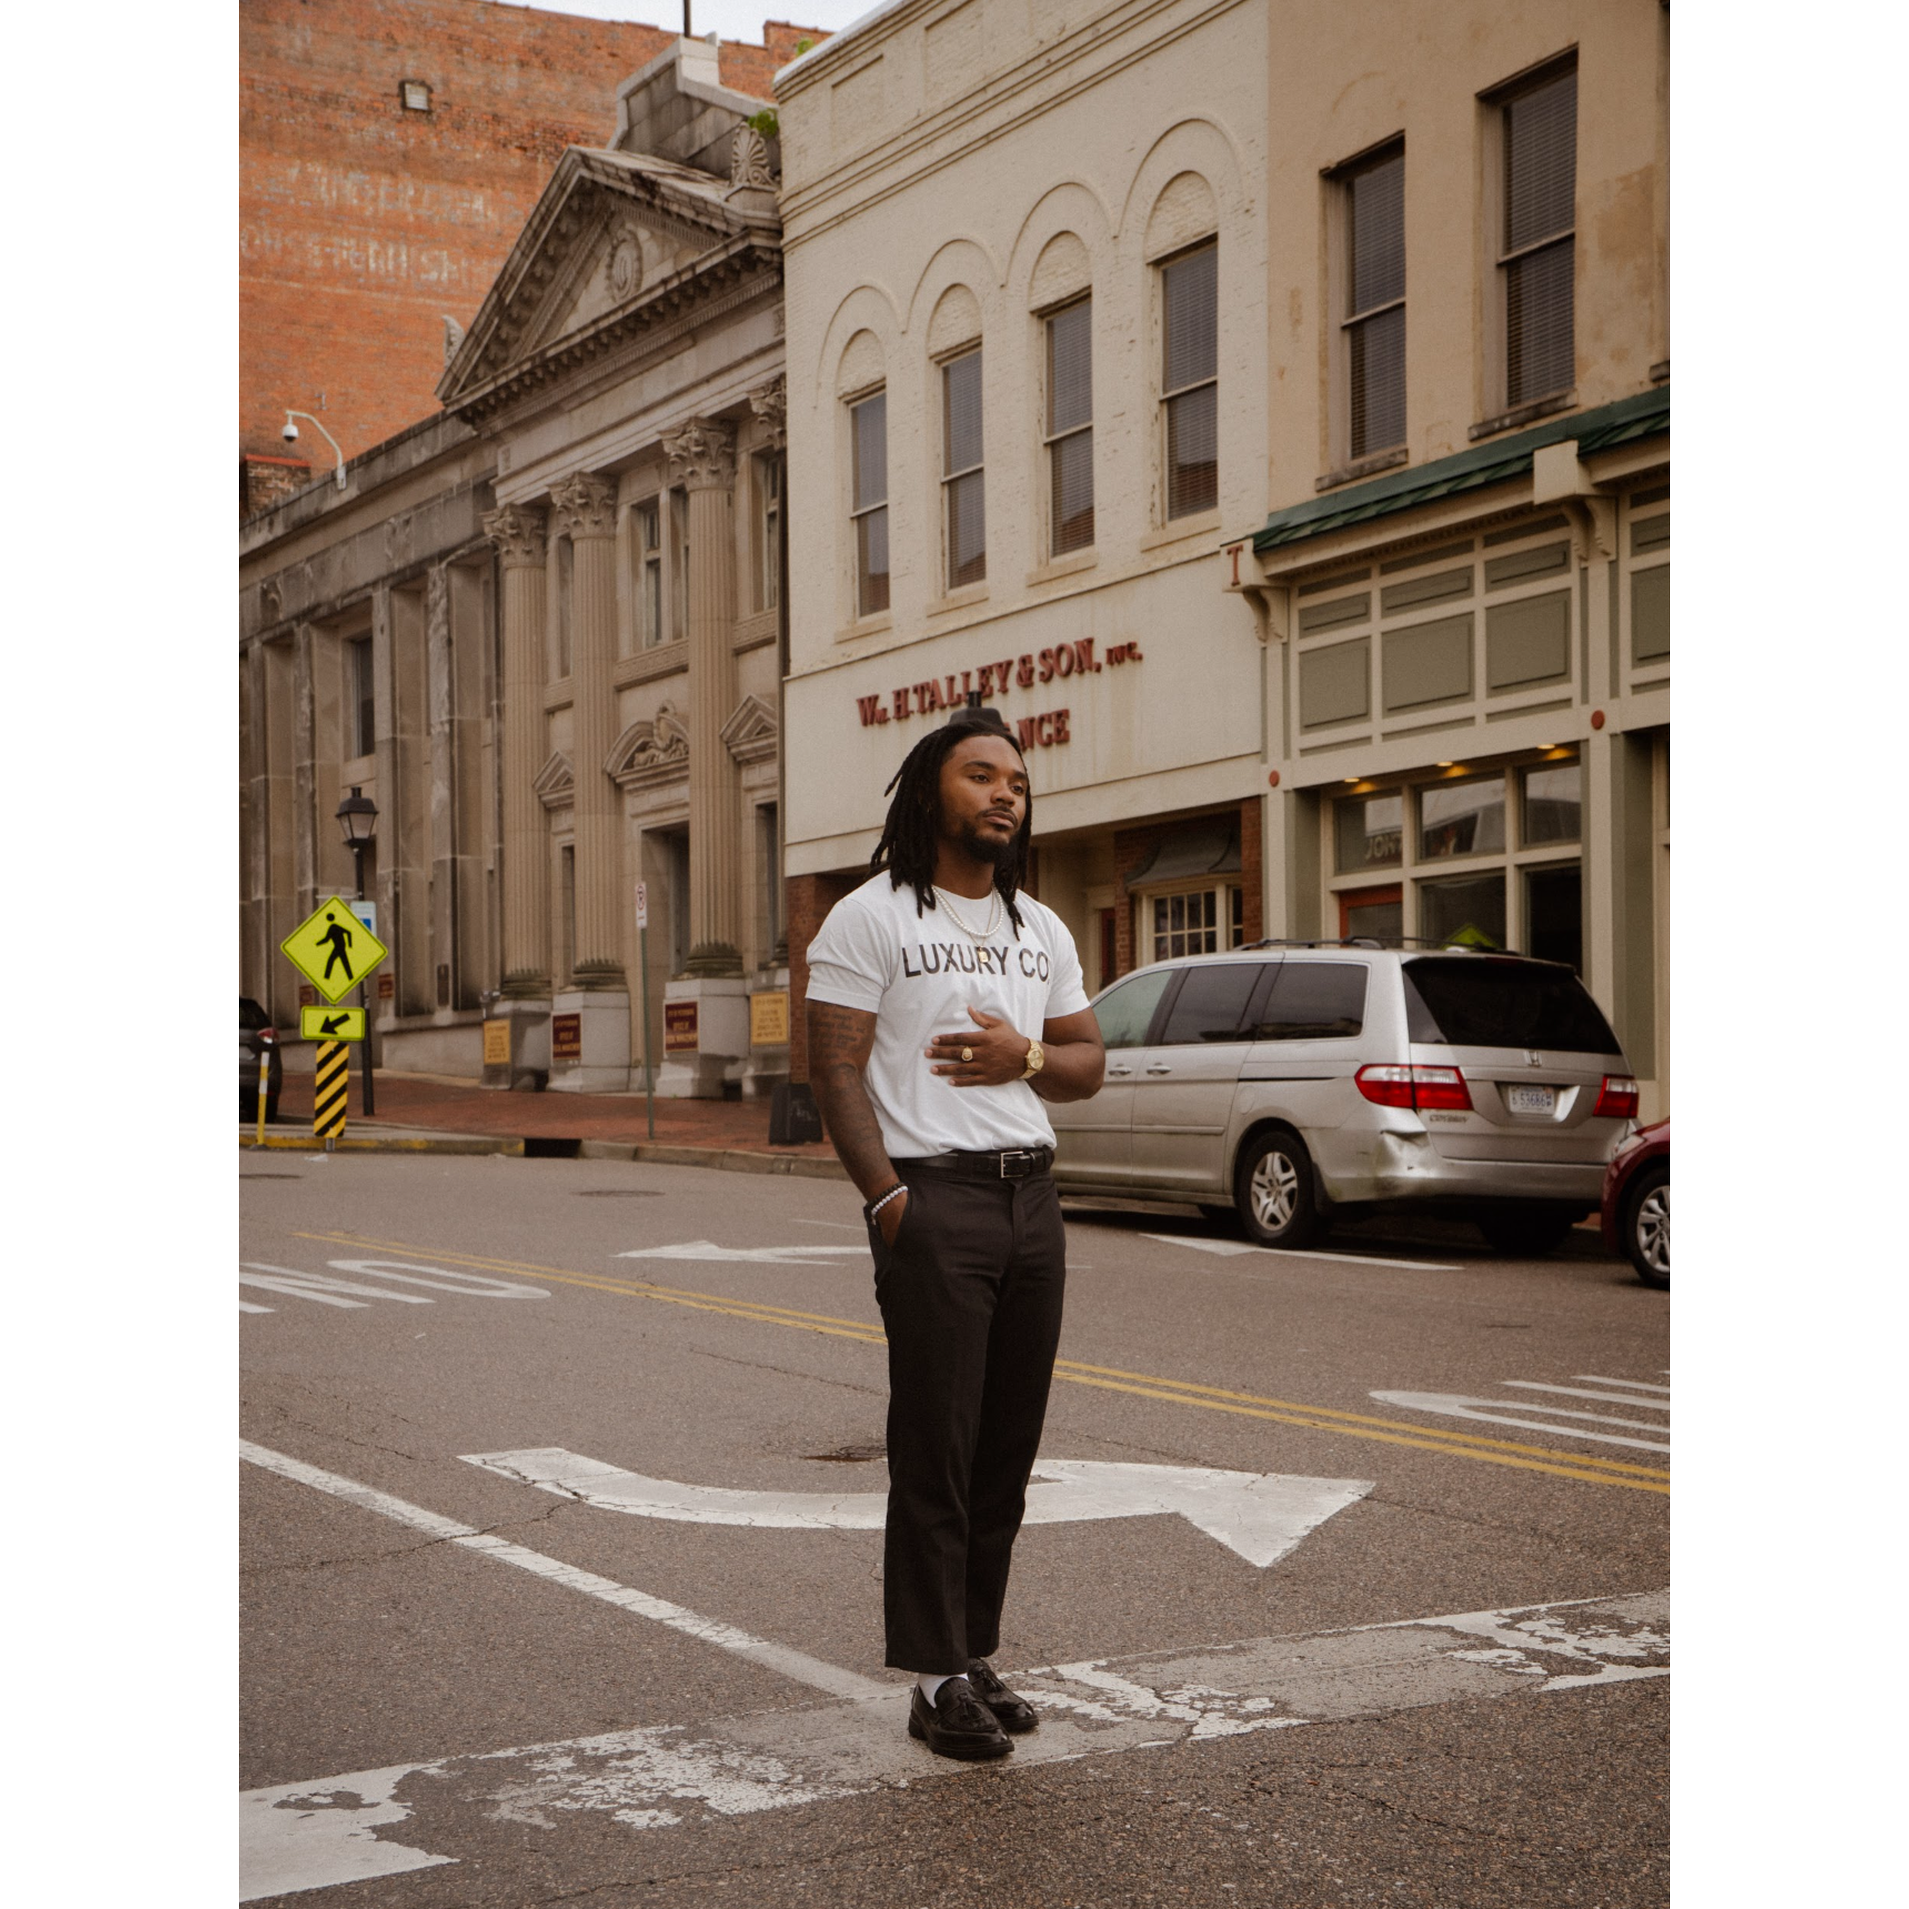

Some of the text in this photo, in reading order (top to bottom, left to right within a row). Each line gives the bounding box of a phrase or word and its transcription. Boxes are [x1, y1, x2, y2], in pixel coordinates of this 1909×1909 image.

[912, 659, 1013, 715] TALLEY
[1016, 654, 1034, 688] &
[1003, 708, 1070, 752] NCE
[901, 943, 1009, 978] LUXURY
